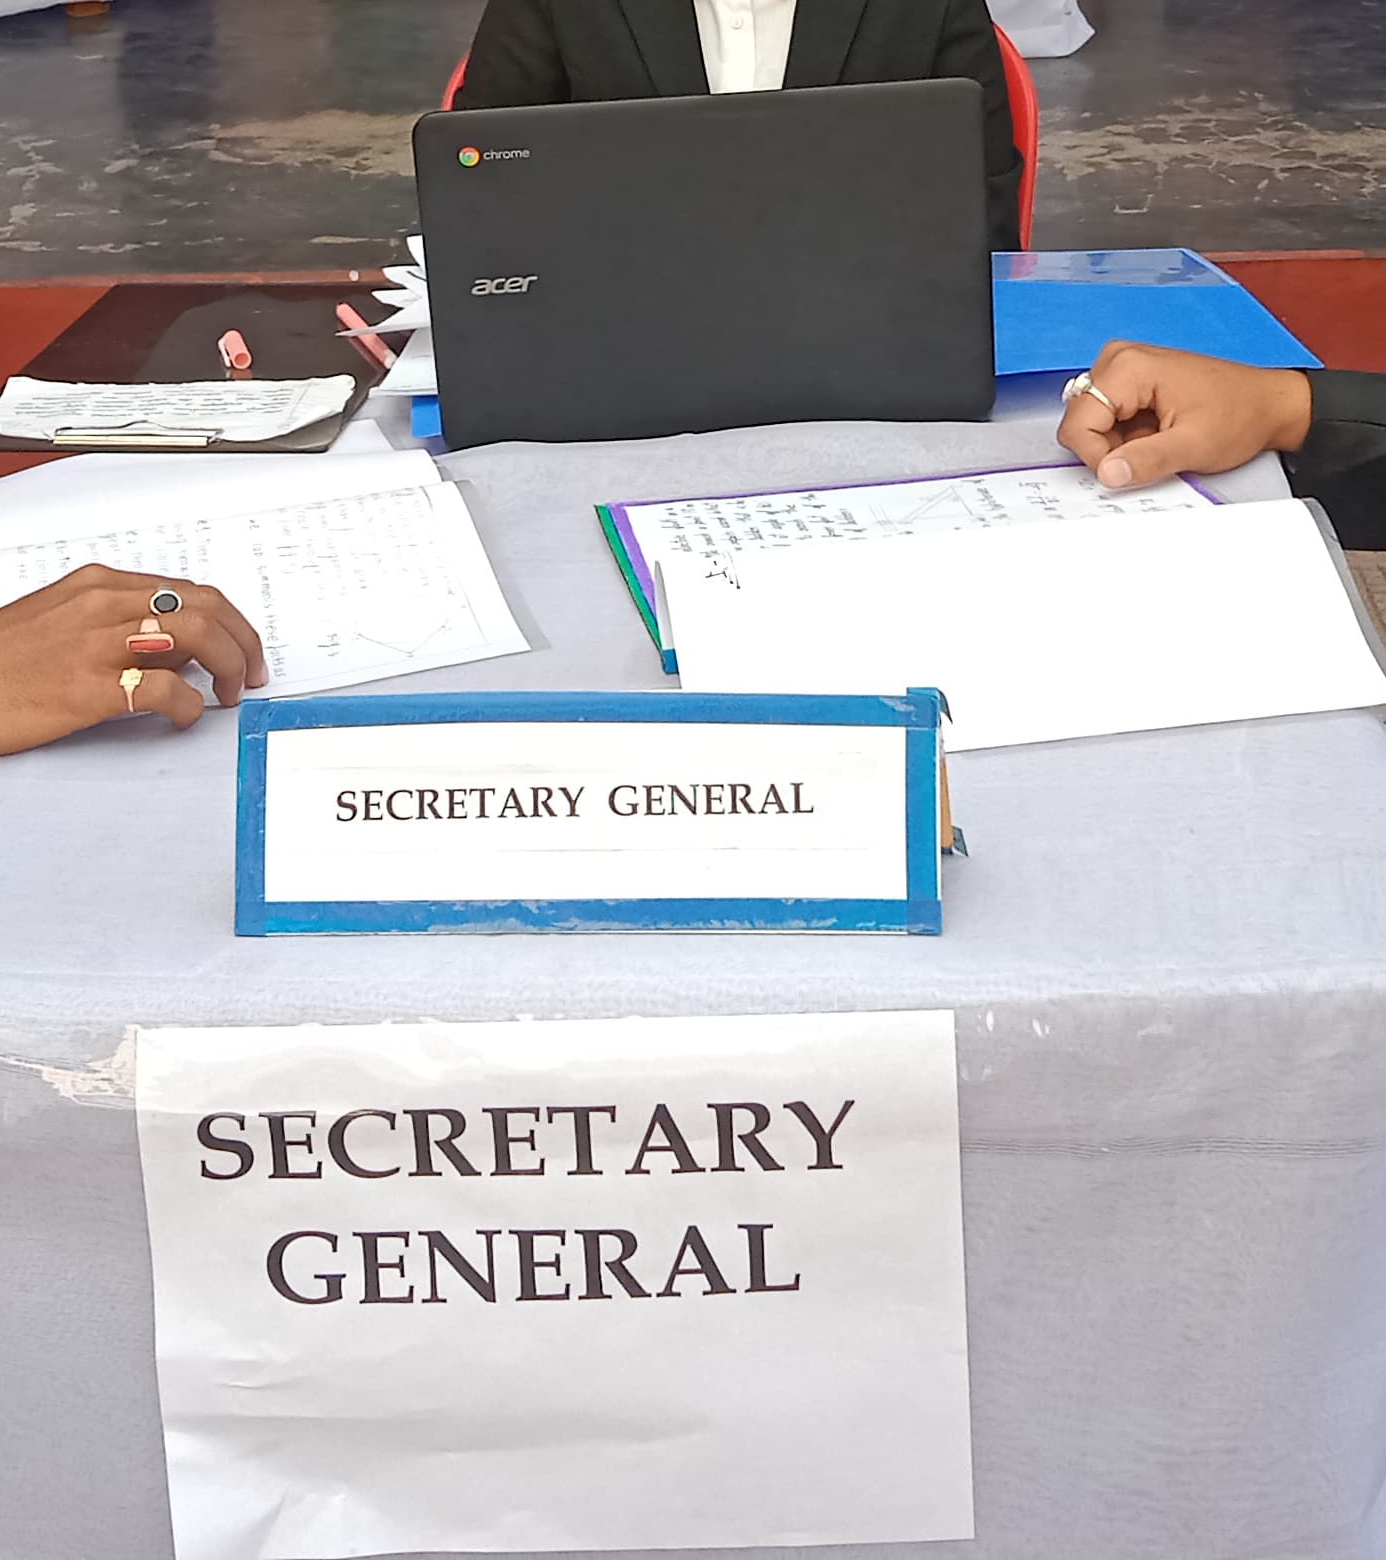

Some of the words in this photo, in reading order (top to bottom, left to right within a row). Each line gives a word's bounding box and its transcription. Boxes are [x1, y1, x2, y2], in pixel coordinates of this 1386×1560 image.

[483, 147, 531, 160] chrome
[471, 275, 538, 295] acer
[335, 785, 586, 823] SECRETARY
[607, 781, 816, 818] GENERAL
[196, 1099, 856, 1183] SECRETARY
[265, 1223, 801, 1307] GENERAL
